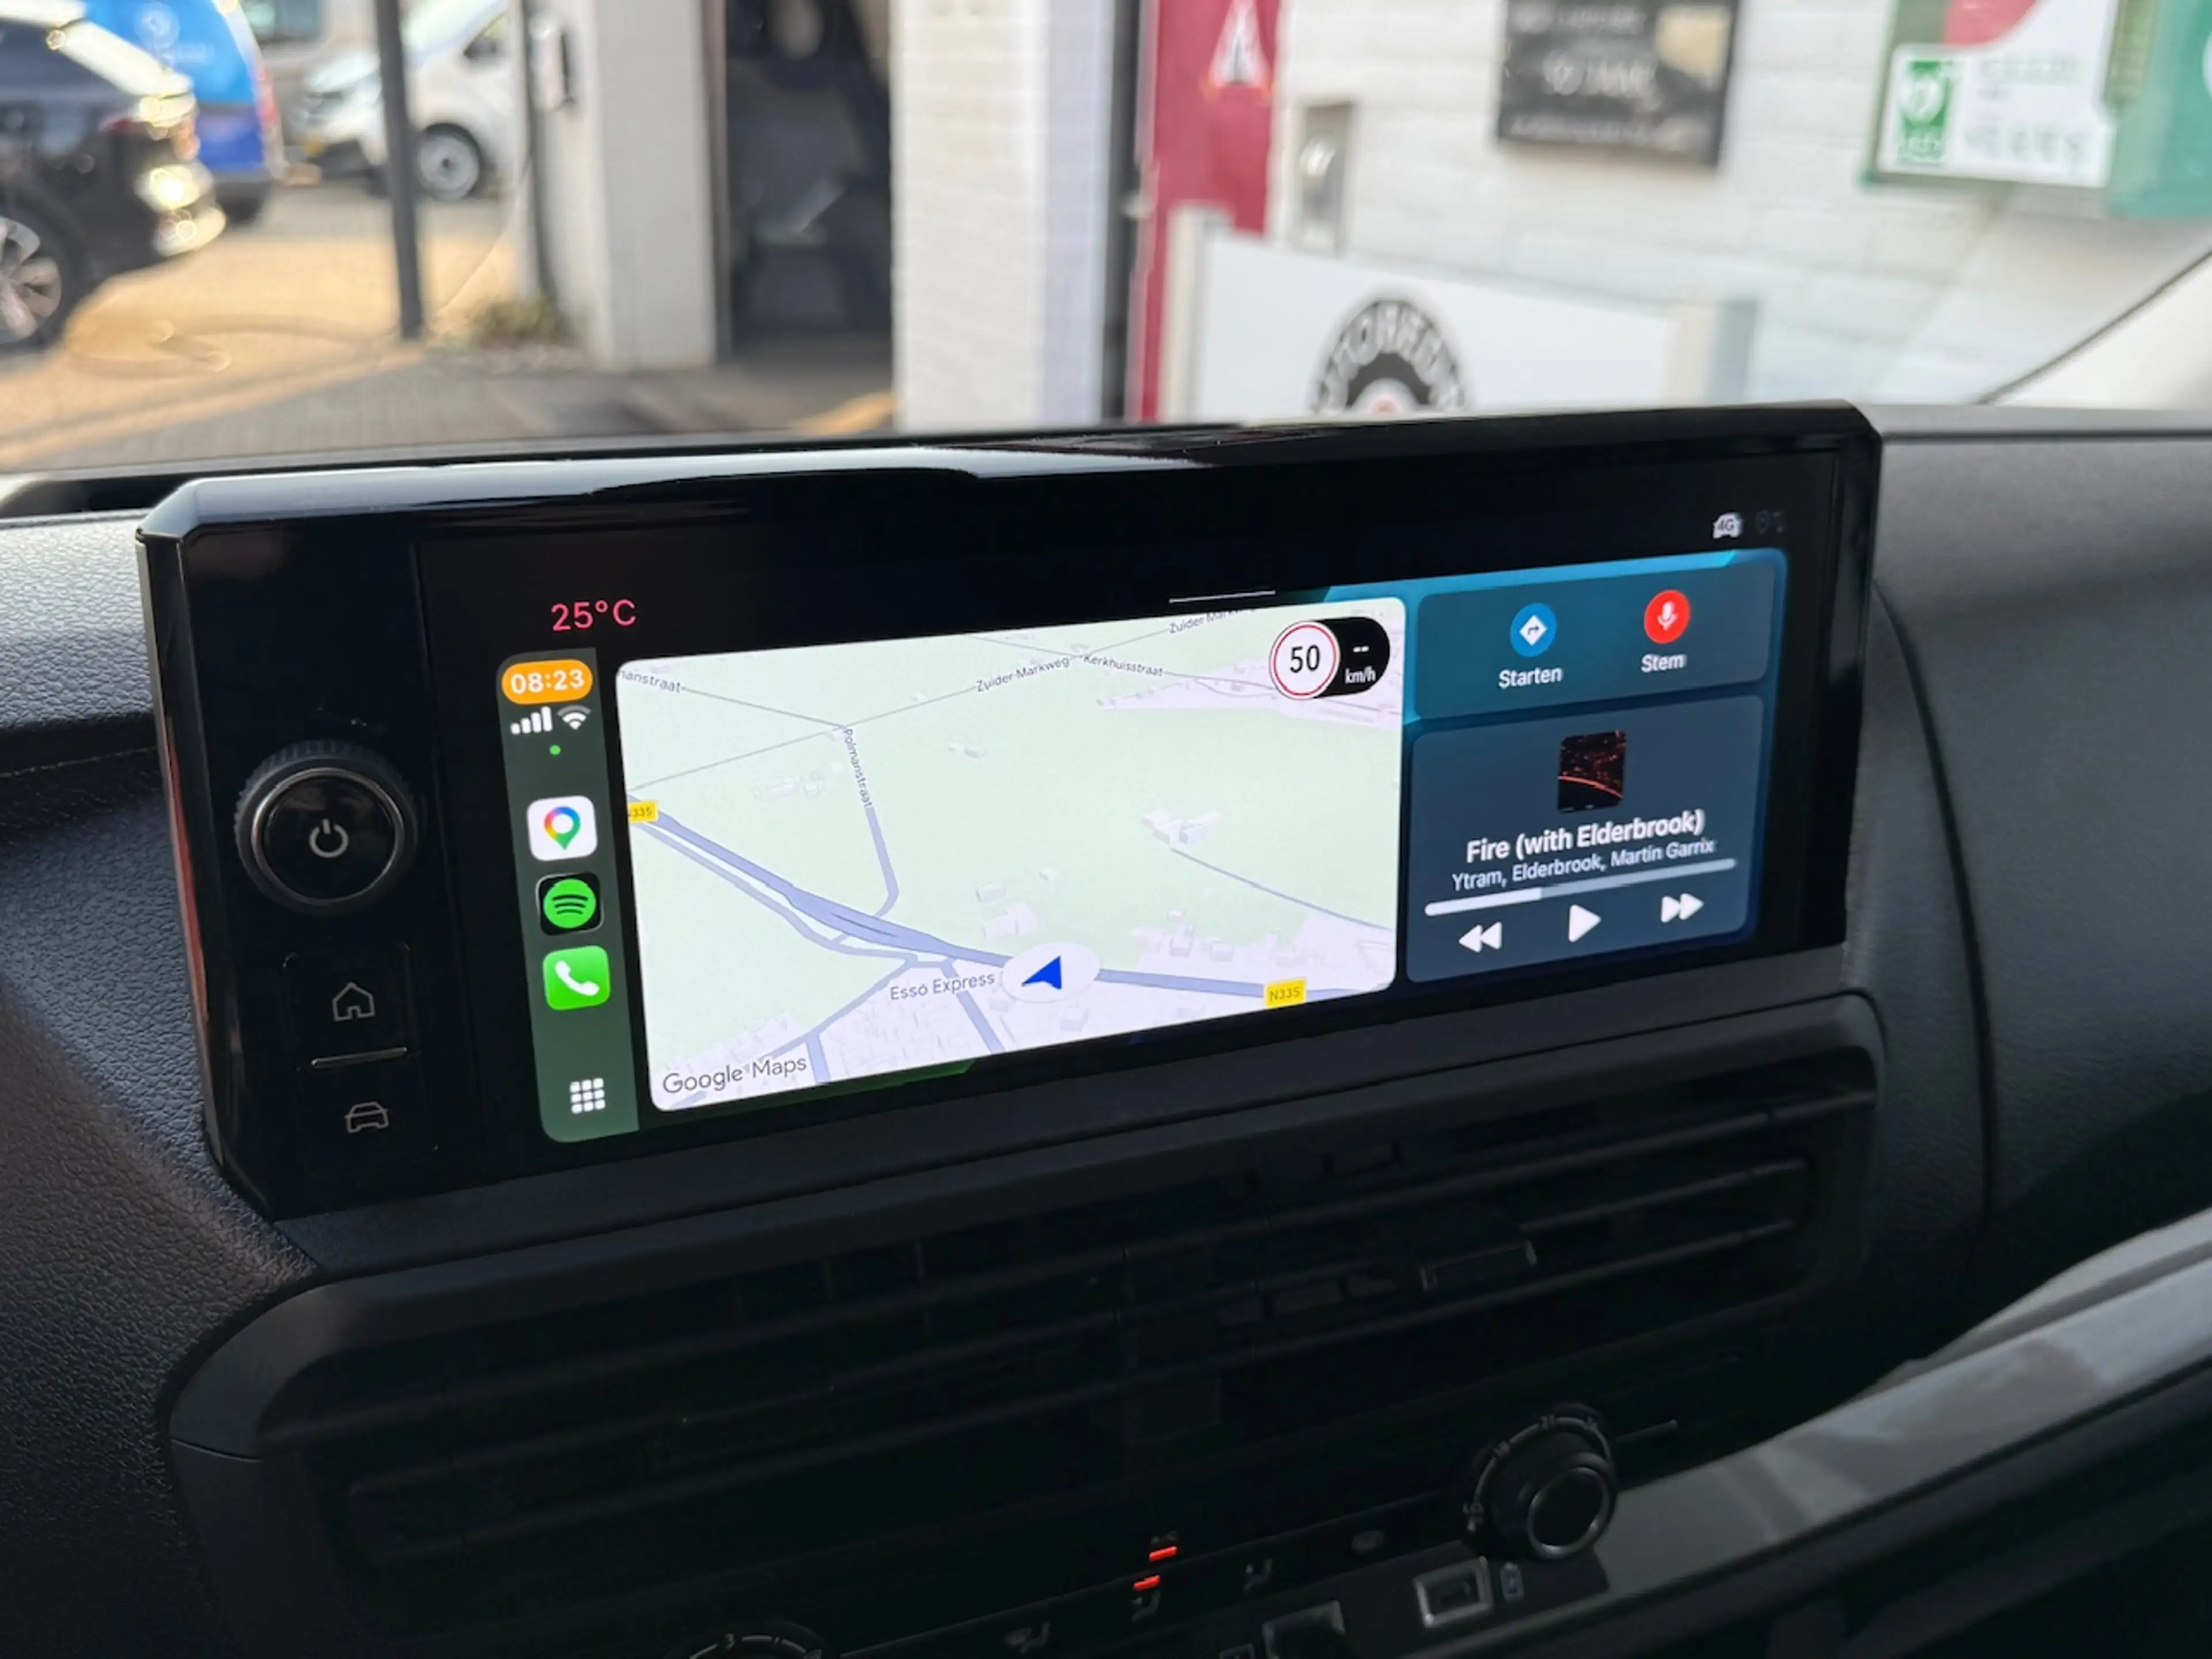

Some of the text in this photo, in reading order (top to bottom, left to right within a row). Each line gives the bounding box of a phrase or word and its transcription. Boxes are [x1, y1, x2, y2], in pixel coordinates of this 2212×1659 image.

[551, 599, 636, 631] 25°C
[1084, 655, 1162, 677] Kerkhuisstraat
[1290, 644, 1320, 673] 50
[1641, 653, 1687, 673] Stem
[510, 668, 585, 695] 08:23
[975, 657, 1070, 692] Zuider Markweg
[1344, 665, 1376, 684] km/h
[1498, 666, 1563, 690] Starten
[843, 728, 872, 808] Polmanstraat
[627, 806, 653, 819] 335
[1467, 809, 1705, 863] Fire (with Elderbrook)
[1452, 837, 1716, 891] Ytram, Elderbrook, Martin Garrix
[889, 974, 995, 1000] Esso Express
[1269, 986, 1301, 1002] N335
[662, 1058, 807, 1093] Google Maps
